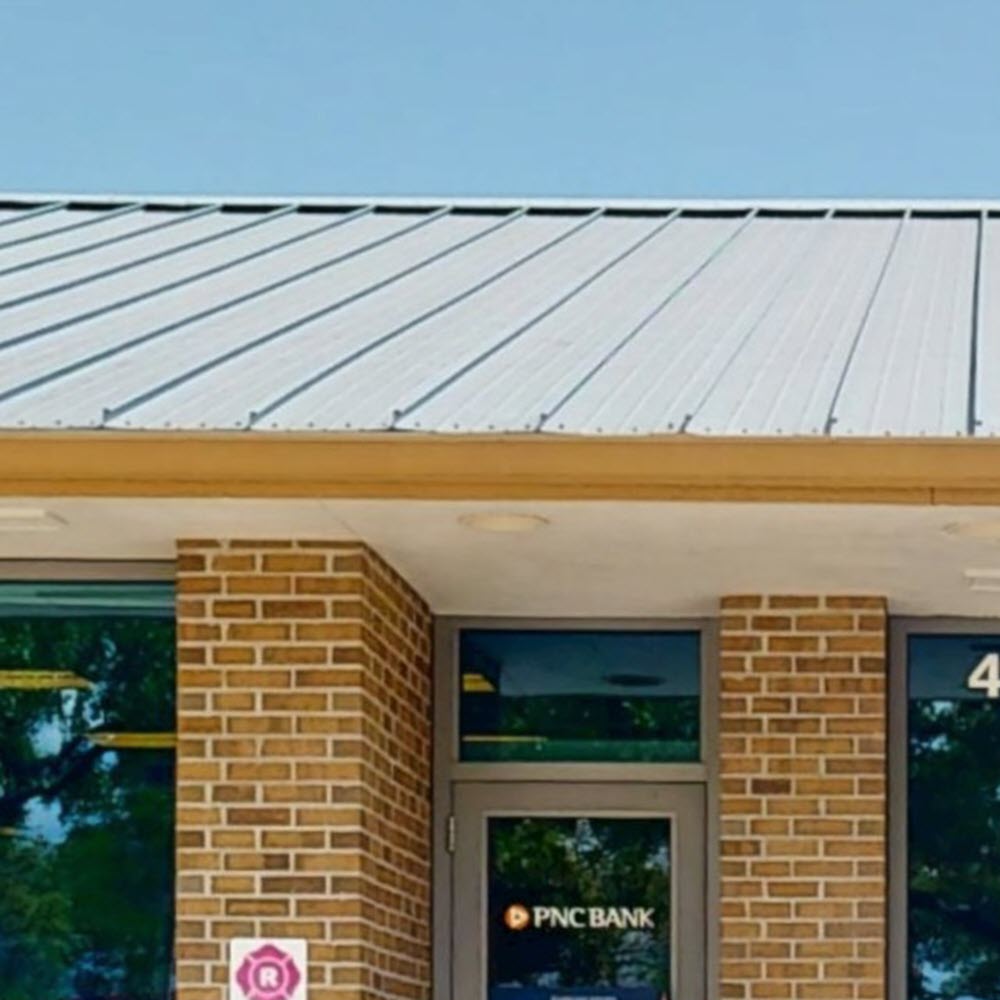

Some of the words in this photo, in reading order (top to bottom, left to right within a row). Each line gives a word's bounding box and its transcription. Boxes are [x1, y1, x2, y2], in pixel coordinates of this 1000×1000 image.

[532, 905, 586, 928] PNC
[588, 905, 656, 929] BANK
[260, 966, 278, 988] R
